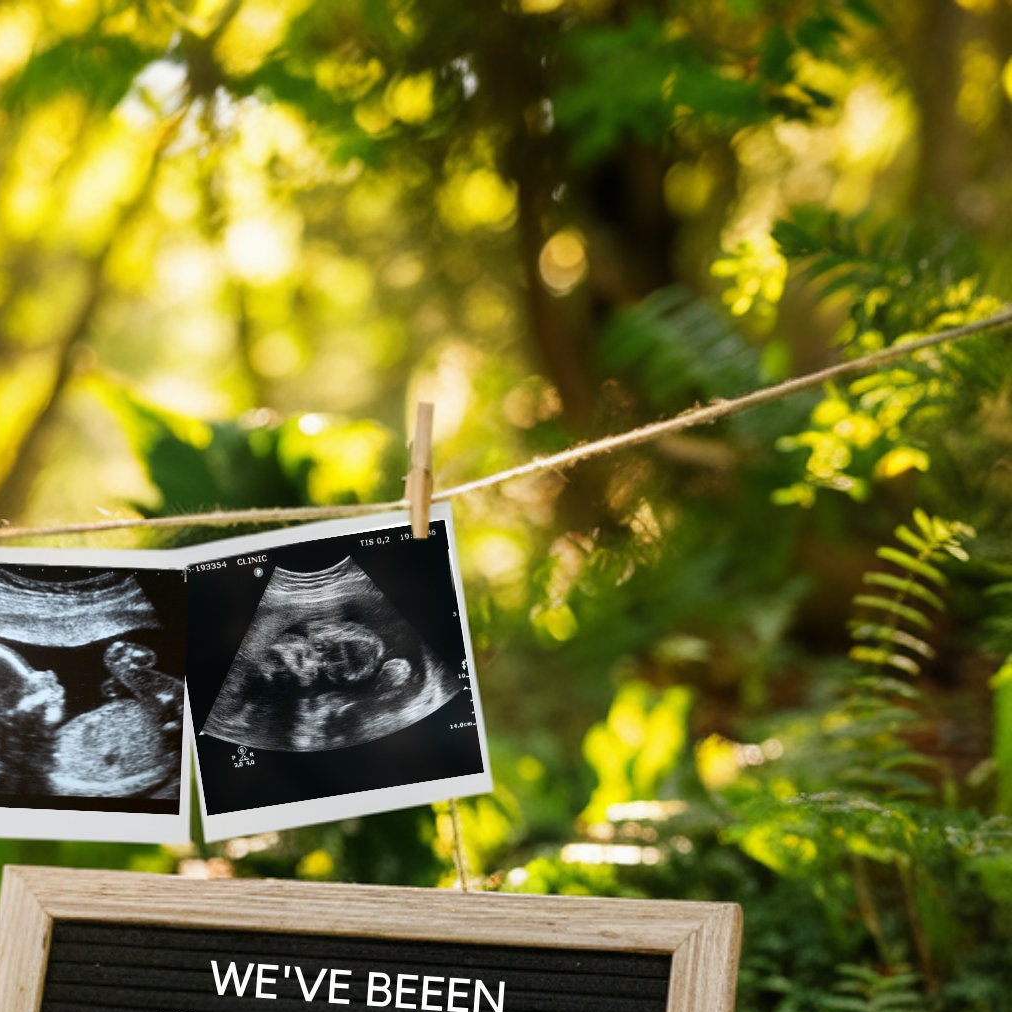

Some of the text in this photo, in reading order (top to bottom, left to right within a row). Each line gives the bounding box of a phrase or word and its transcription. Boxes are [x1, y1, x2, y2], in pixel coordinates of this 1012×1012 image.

[360, 538, 374, 547] TIS
[236, 554, 268, 566] CLINIC
[210, 960, 352, 1005] WE'VE
